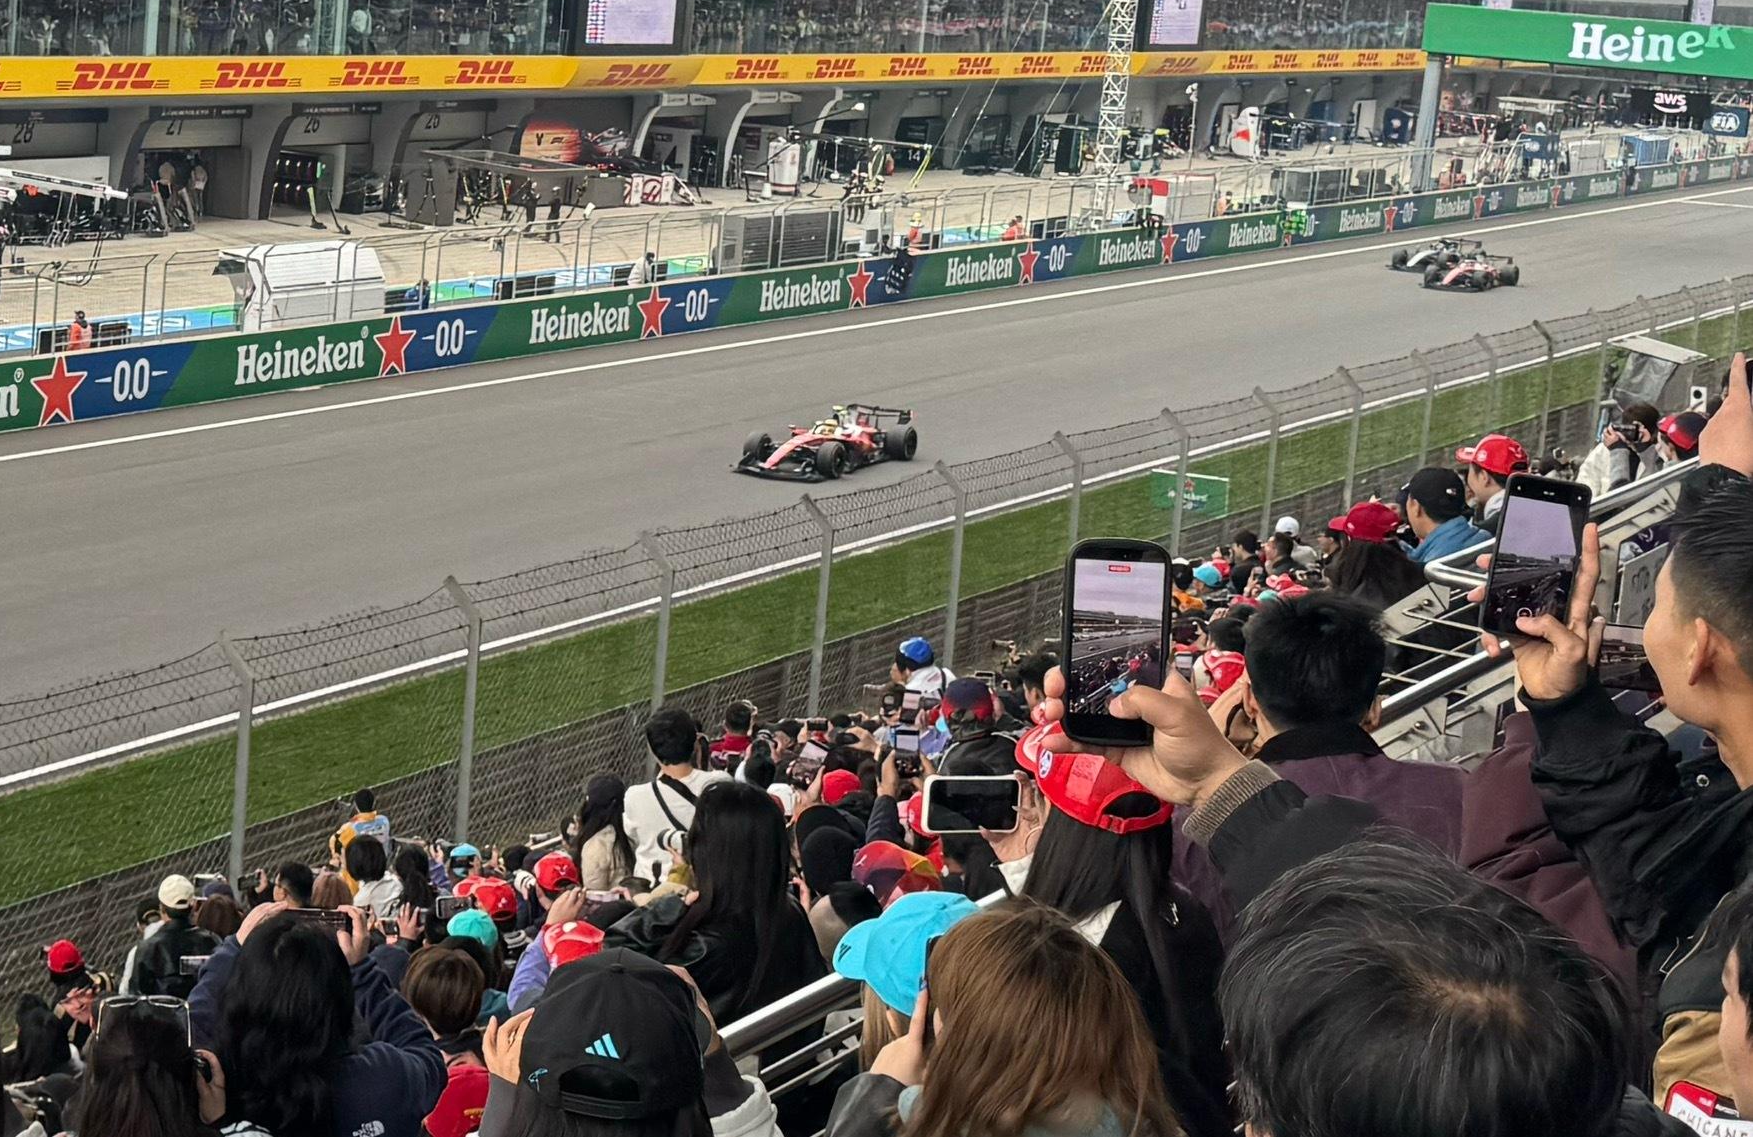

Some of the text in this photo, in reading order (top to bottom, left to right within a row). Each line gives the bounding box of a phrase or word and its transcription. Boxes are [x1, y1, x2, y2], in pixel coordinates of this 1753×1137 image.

[72, 62, 155, 90] DHL
[215, 61, 289, 89] DHL
[342, 61, 407, 86] DHL
[457, 60, 516, 84] DHL
[601, 63, 672, 87] DHL
[734, 59, 780, 79] DHL
[813, 58, 857, 78] DHL
[888, 57, 929, 76] DHL
[957, 56, 993, 75] DHL
[1021, 55, 1054, 74] DHL
[1654, 92, 1687, 106] aws
[13, 123, 34, 145] 28
[1712, 114, 1736, 131] FIA
[1340, 208, 1381, 233] Heineken
[1229, 219, 1278, 248] Heineken
[1099, 234, 1156, 266] Heineken
[945, 252, 1013, 287] Heineken
[759, 273, 841, 313] Heineken
[529, 300, 631, 344] Heineken
[235, 333, 365, 386] Heineken
